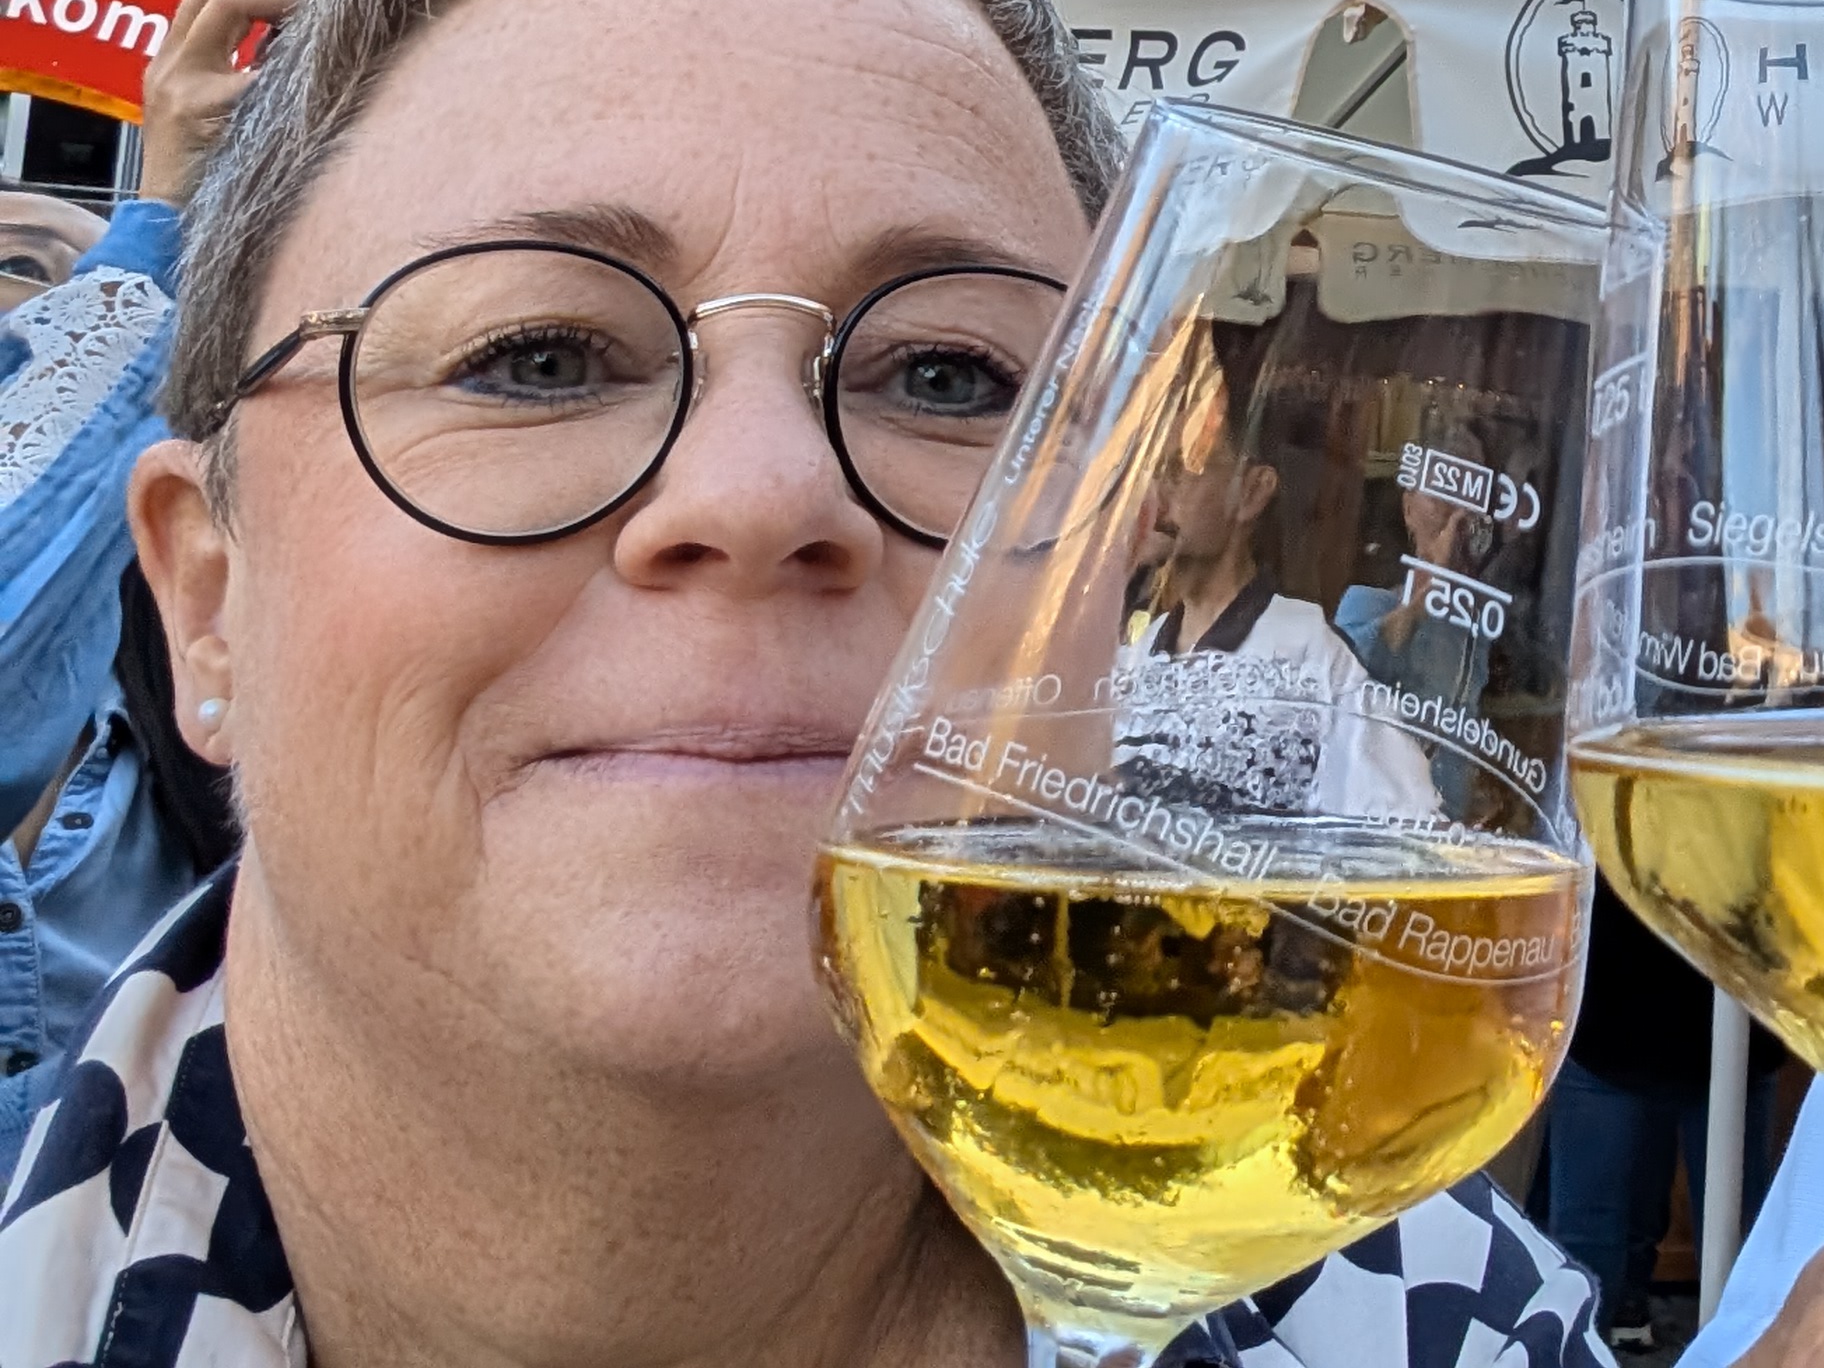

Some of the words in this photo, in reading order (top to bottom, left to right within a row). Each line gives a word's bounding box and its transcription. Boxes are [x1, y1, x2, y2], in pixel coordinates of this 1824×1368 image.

[924, 715, 991, 772] Bad
[996, 741, 1279, 880] Friedrichshall
[1307, 873, 1398, 942] Bad
[1398, 911, 1557, 976] Rappenau
